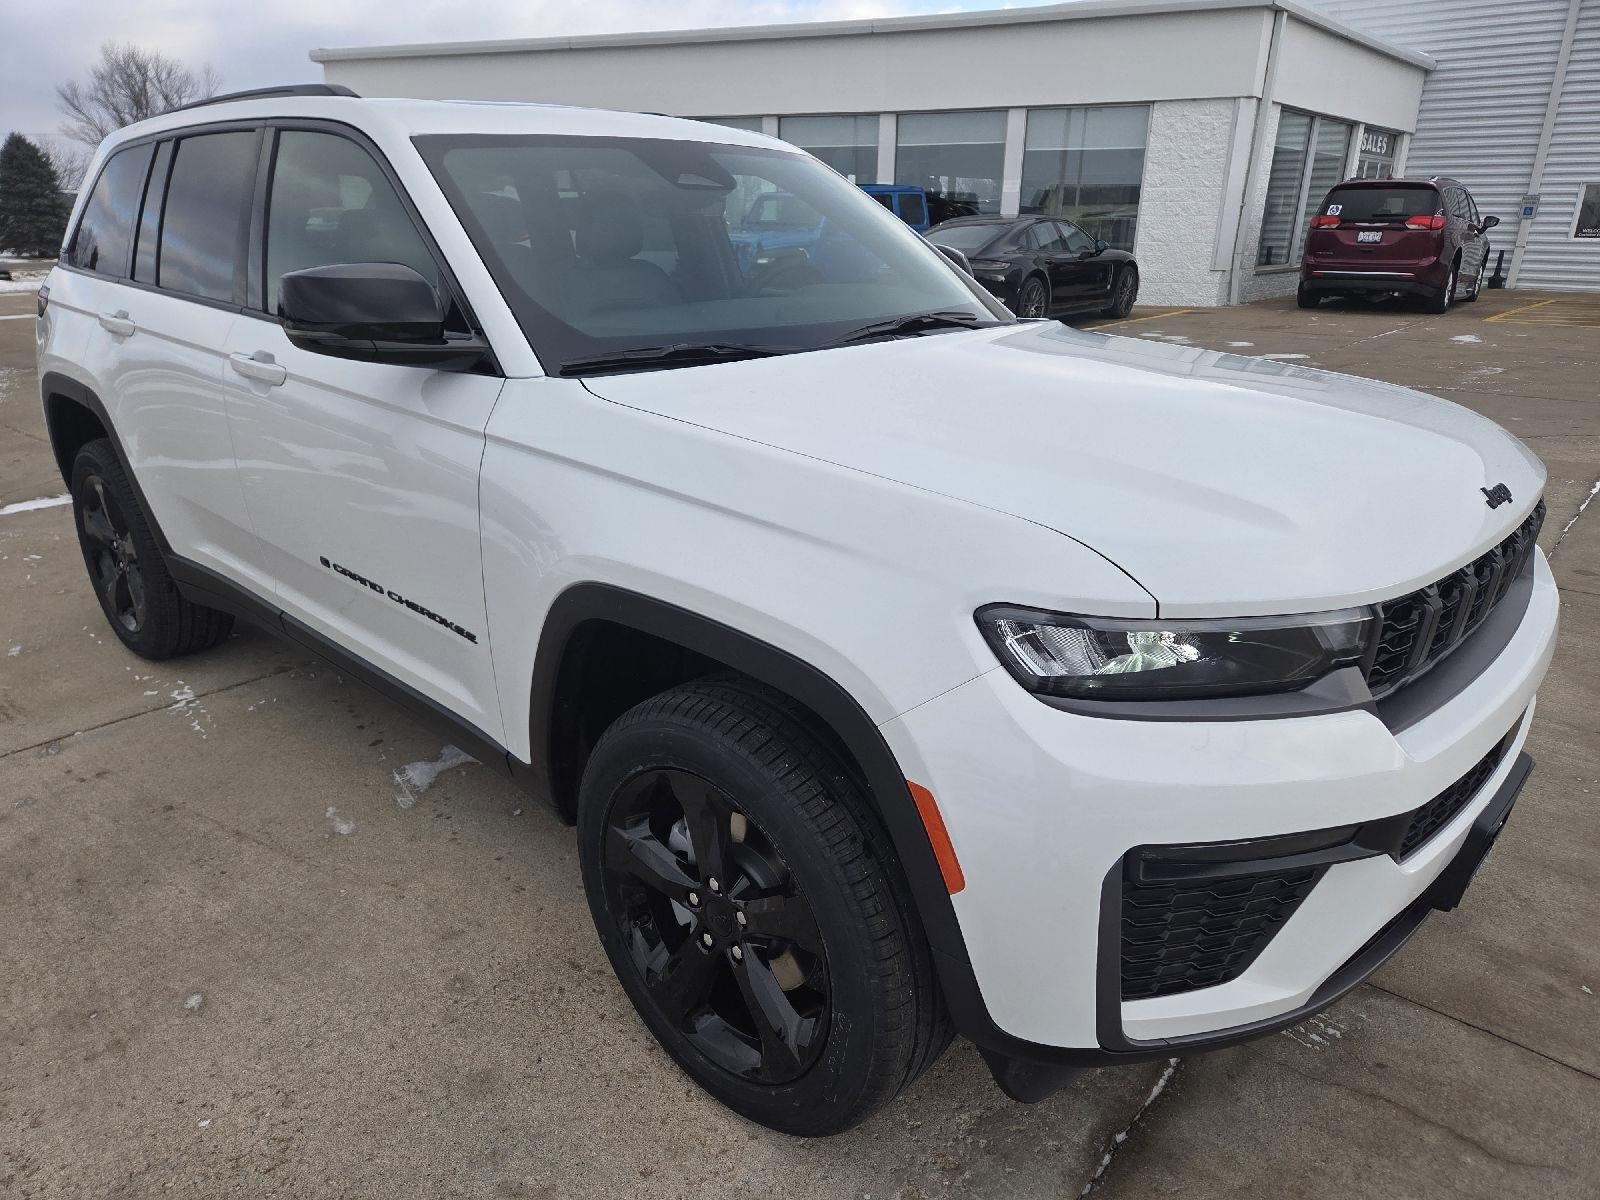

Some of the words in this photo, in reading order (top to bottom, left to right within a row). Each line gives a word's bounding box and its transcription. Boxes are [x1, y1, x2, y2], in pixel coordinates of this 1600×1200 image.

[1361, 133, 1388, 154] SALES
[1480, 482, 1513, 510] Jeep
[332, 562, 385, 595] GRAND
[387, 590, 479, 645] CHEROKEE
